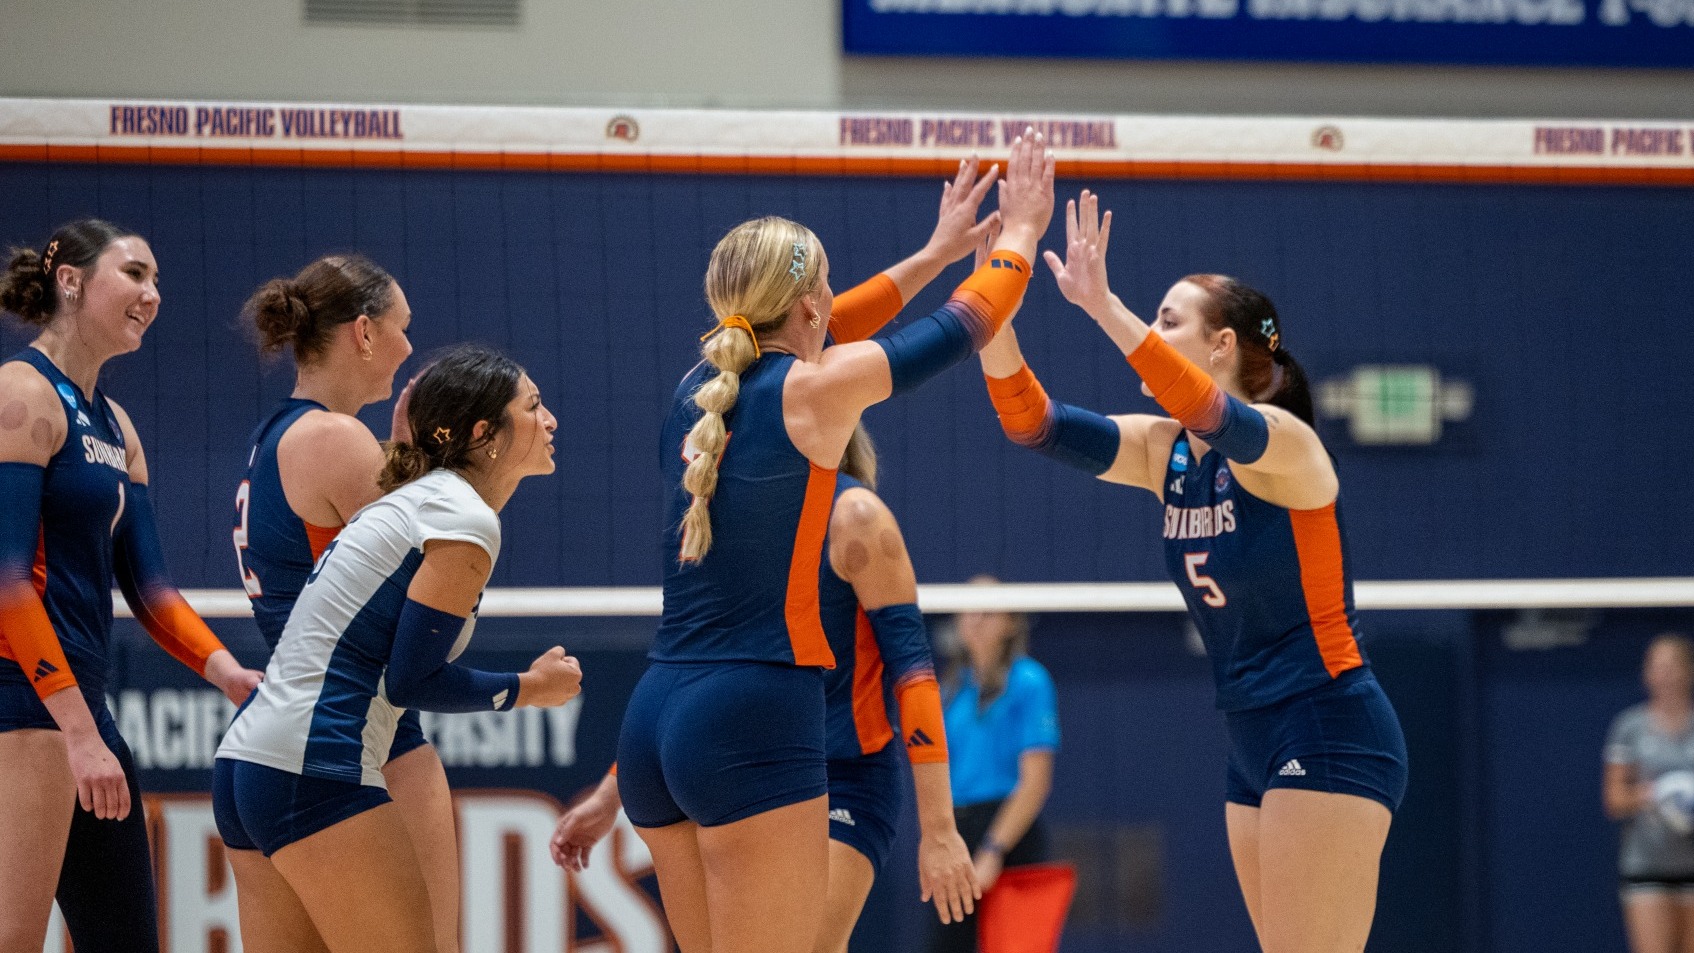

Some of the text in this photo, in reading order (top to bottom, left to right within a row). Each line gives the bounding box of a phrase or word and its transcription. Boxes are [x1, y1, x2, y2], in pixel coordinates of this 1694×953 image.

[110, 105, 404, 139] FRESNO PACIFIC VOLLEYBALL
[840, 118, 1117, 149] FRESNO PACIFIC VOEYBALL
[1184, 552, 1227, 608] 5
